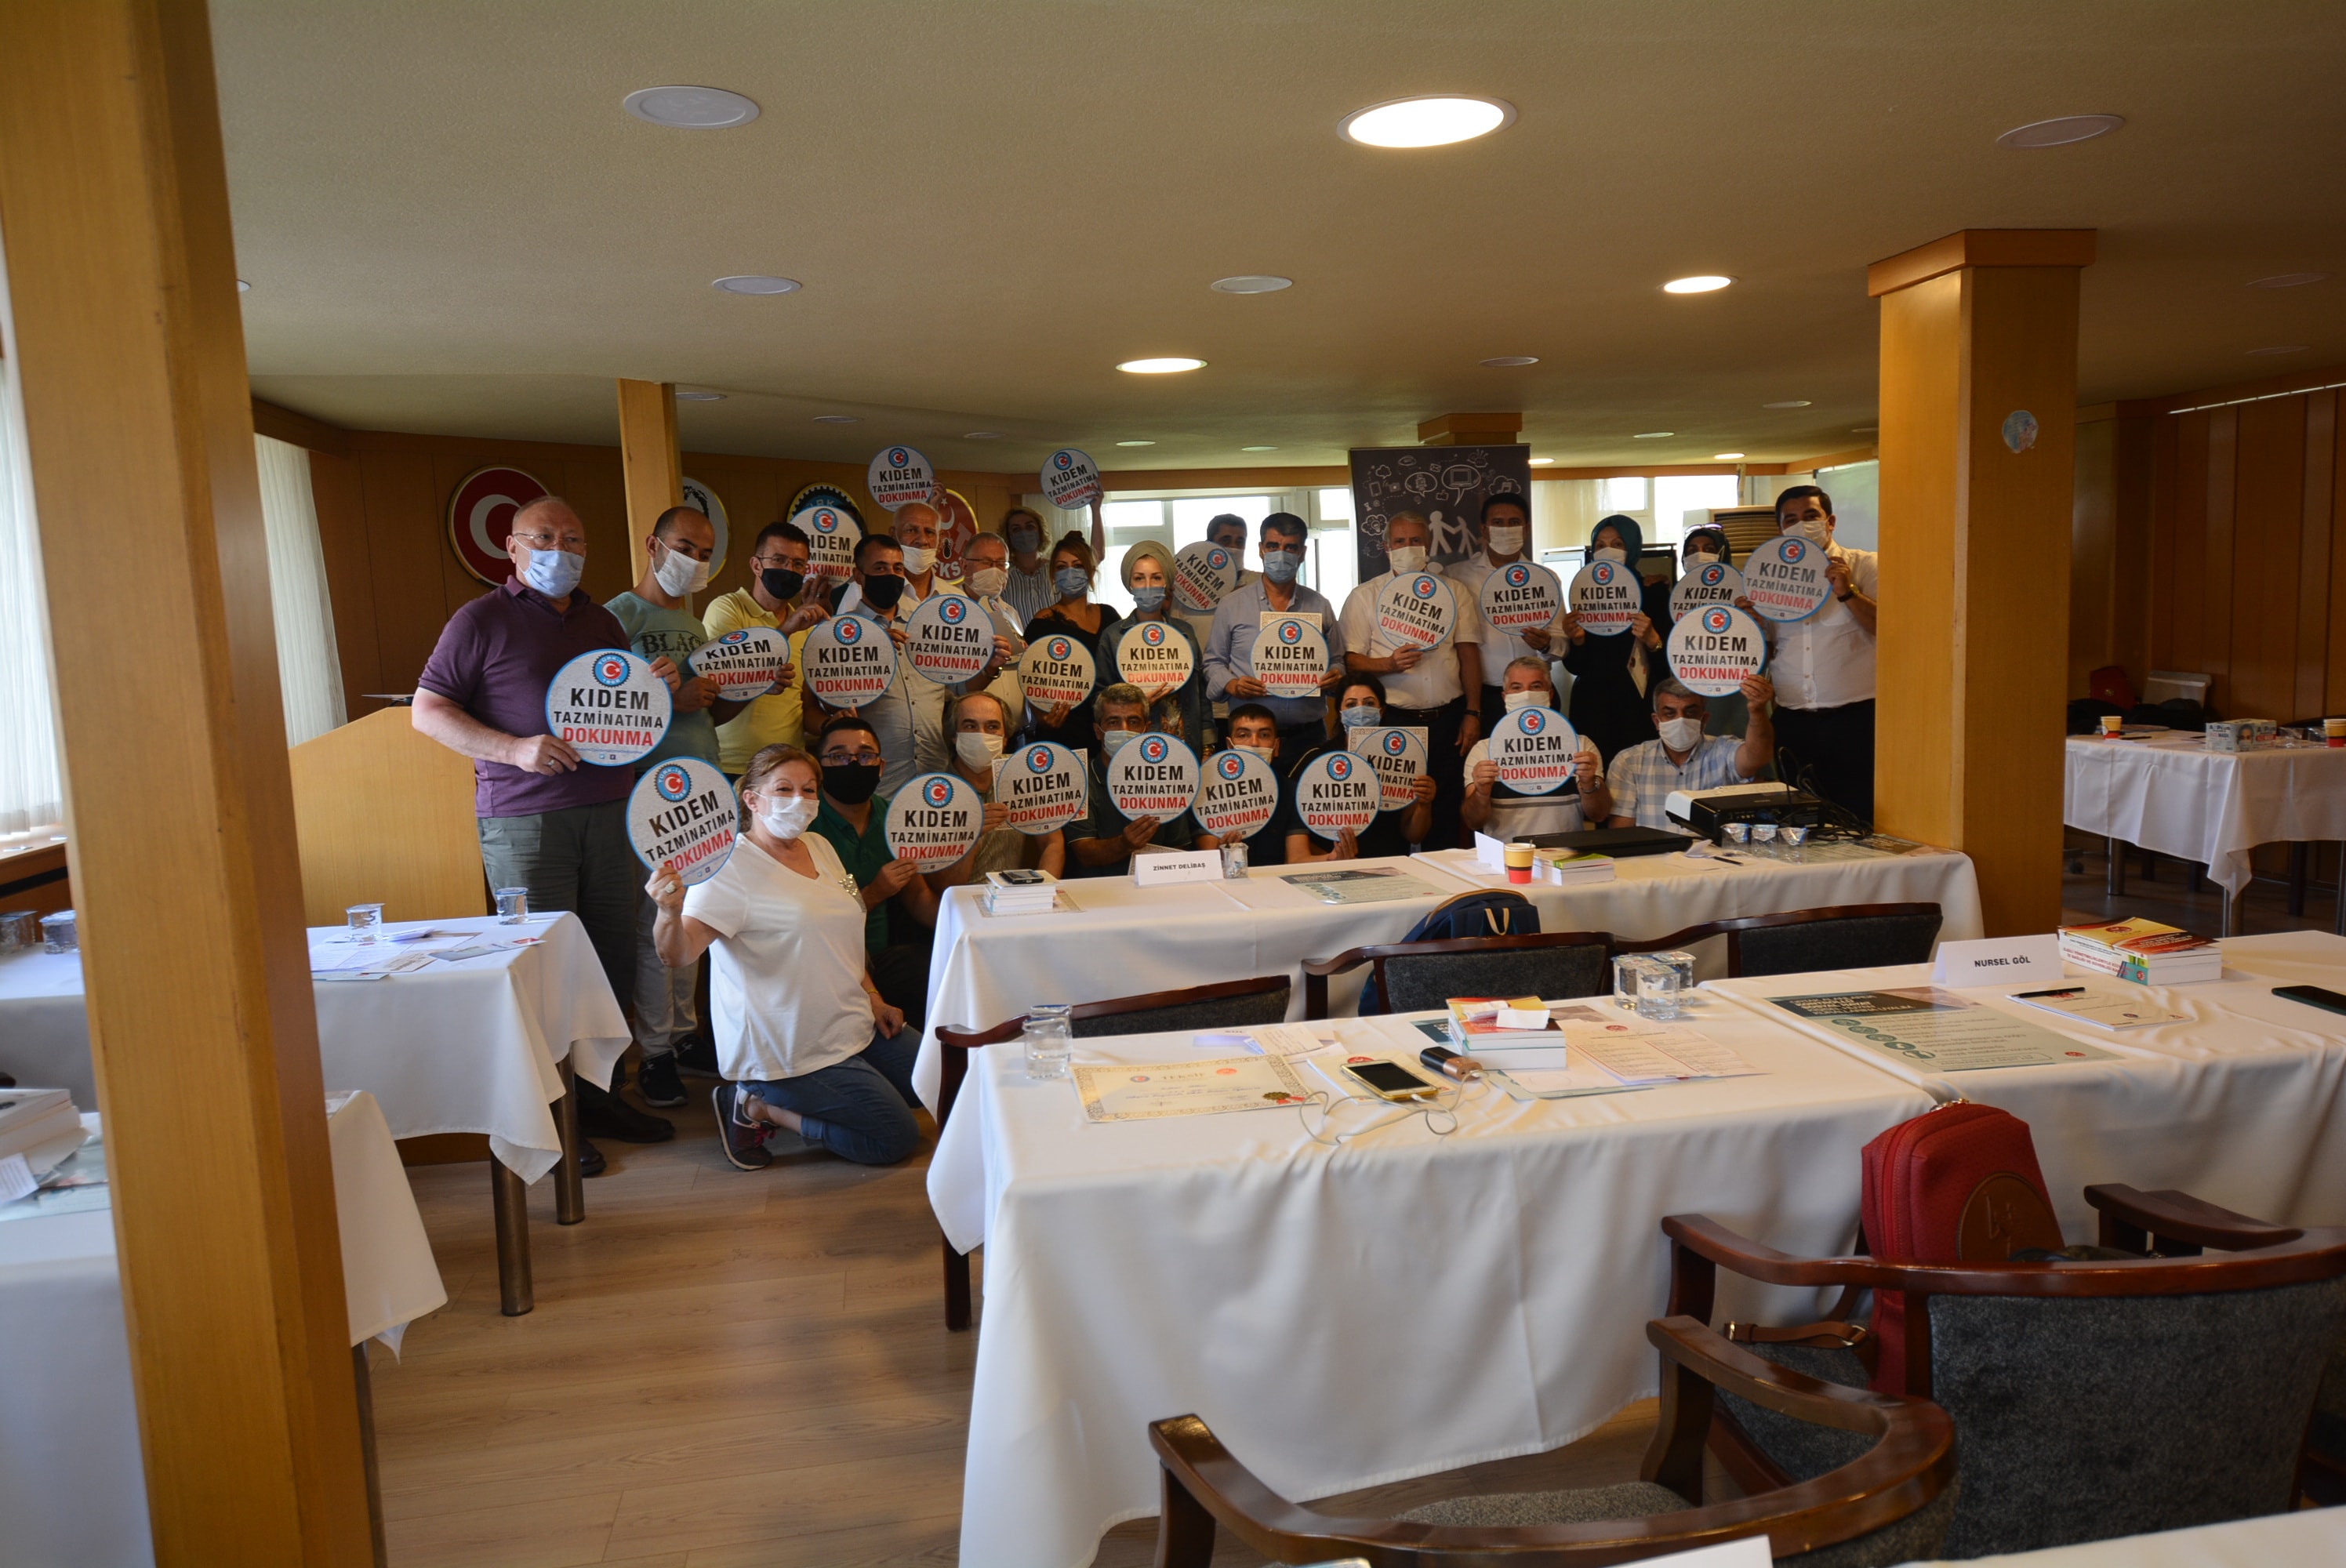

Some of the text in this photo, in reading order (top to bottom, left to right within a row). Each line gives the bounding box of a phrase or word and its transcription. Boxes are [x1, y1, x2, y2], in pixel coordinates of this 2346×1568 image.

[879, 467, 922, 483] KIDEM
[1050, 464, 1088, 487] KIDEM
[873, 481, 932, 493] TAZMİNATIMA
[1048, 474, 1098, 499] TAZMİNATIMA
[879, 490, 927, 503] DOKUNMA
[808, 535, 850, 551] IDEM
[808, 550, 855, 564] MİNATIM
[805, 563, 850, 578] OKUNMA
[1186, 554, 1225, 590] KIDEM
[1759, 562, 1816, 583] KIDEM
[1175, 557, 1221, 605] TAZMİNATIMA
[1746, 578, 1823, 597] TAZMİNATIMA
[1494, 586, 1545, 603] KIDEM
[1581, 586, 1627, 600] KIDEM
[1684, 587, 1733, 601] KIDEM
[1750, 590, 1813, 610] DOKUNMA
[1393, 592, 1443, 621] KIDEM
[1486, 601, 1556, 615] TAZMİNATIMA
[1572, 601, 1637, 611] TAZMİNATIMA
[1380, 604, 1445, 635] TAZMİNATIMA
[1493, 610, 1551, 625] DOKUNMA
[1578, 612, 1632, 622] DOKUNMA
[922, 624, 979, 643] KIDEM
[1381, 616, 1436, 644] DOKUNMA
[641, 632, 704, 654] BLAC
[705, 640, 771, 659] KIDEM
[910, 642, 988, 657] TAZMİNATIMA
[1685, 635, 1747, 652] KIDEM
[819, 646, 878, 663] KIDEM
[1131, 648, 1178, 660] KIDEM
[1266, 647, 1315, 659] KIDEM
[1672, 654, 1758, 666] TAZMİNATIMA
[696, 656, 783, 671] TAZMİNATIMA
[915, 655, 980, 670] DOKUNMA
[1033, 660, 1082, 677] KIDEM
[1121, 660, 1189, 671] TAZMİNATIMA
[1255, 662, 1324, 672] TAZMİNATIMA
[708, 670, 775, 686] DOKUNMA
[808, 665, 891, 677] TAZMİNATIMA
[1128, 672, 1185, 683] DOKUNMA
[1261, 673, 1319, 684] DOKUNMA
[1680, 666, 1751, 681] DOKUNMA
[816, 677, 884, 693] DOKUNMA
[1022, 675, 1090, 690] TAZMİNATIMA
[571, 688, 649, 710] KIDEM
[1026, 686, 1083, 702] DOKUNMA
[554, 710, 663, 728] TAZMİNATIMA
[563, 727, 653, 746] DOKUNMA
[1505, 735, 1561, 753] KIDEM
[1367, 754, 1416, 774] KIDEM
[1494, 752, 1574, 767] TAZMİNATIMA
[1124, 765, 1183, 781] KIDEM
[1502, 765, 1567, 780] DOKUNMA
[1013, 771, 1070, 795] KIDEM
[1113, 782, 1194, 794] TAZMİNATIMA
[1206, 778, 1262, 801] KIDEM
[1313, 782, 1366, 798] KIDEM
[1003, 789, 1081, 810] TAZMİNATIMA
[1381, 785, 1414, 800] UNMA
[1120, 797, 1186, 809] DOKUNMA
[1197, 795, 1274, 816] TAZMİNATIMA
[1301, 800, 1376, 812] TAZMİNATIMA
[648, 790, 720, 838] KIDEM
[905, 810, 968, 828] KIDEM
[1009, 802, 1075, 823] DOKUNMA
[1207, 808, 1269, 829] DOKUNMA
[1309, 813, 1369, 826] DOKUNMA
[645, 810, 735, 862] TAZMİNATIMA
[891, 830, 974, 843] TAZMİNATIMA
[899, 844, 964, 860] DOKUNMA
[1974, 955, 2031, 967] NURSEL GÖL
